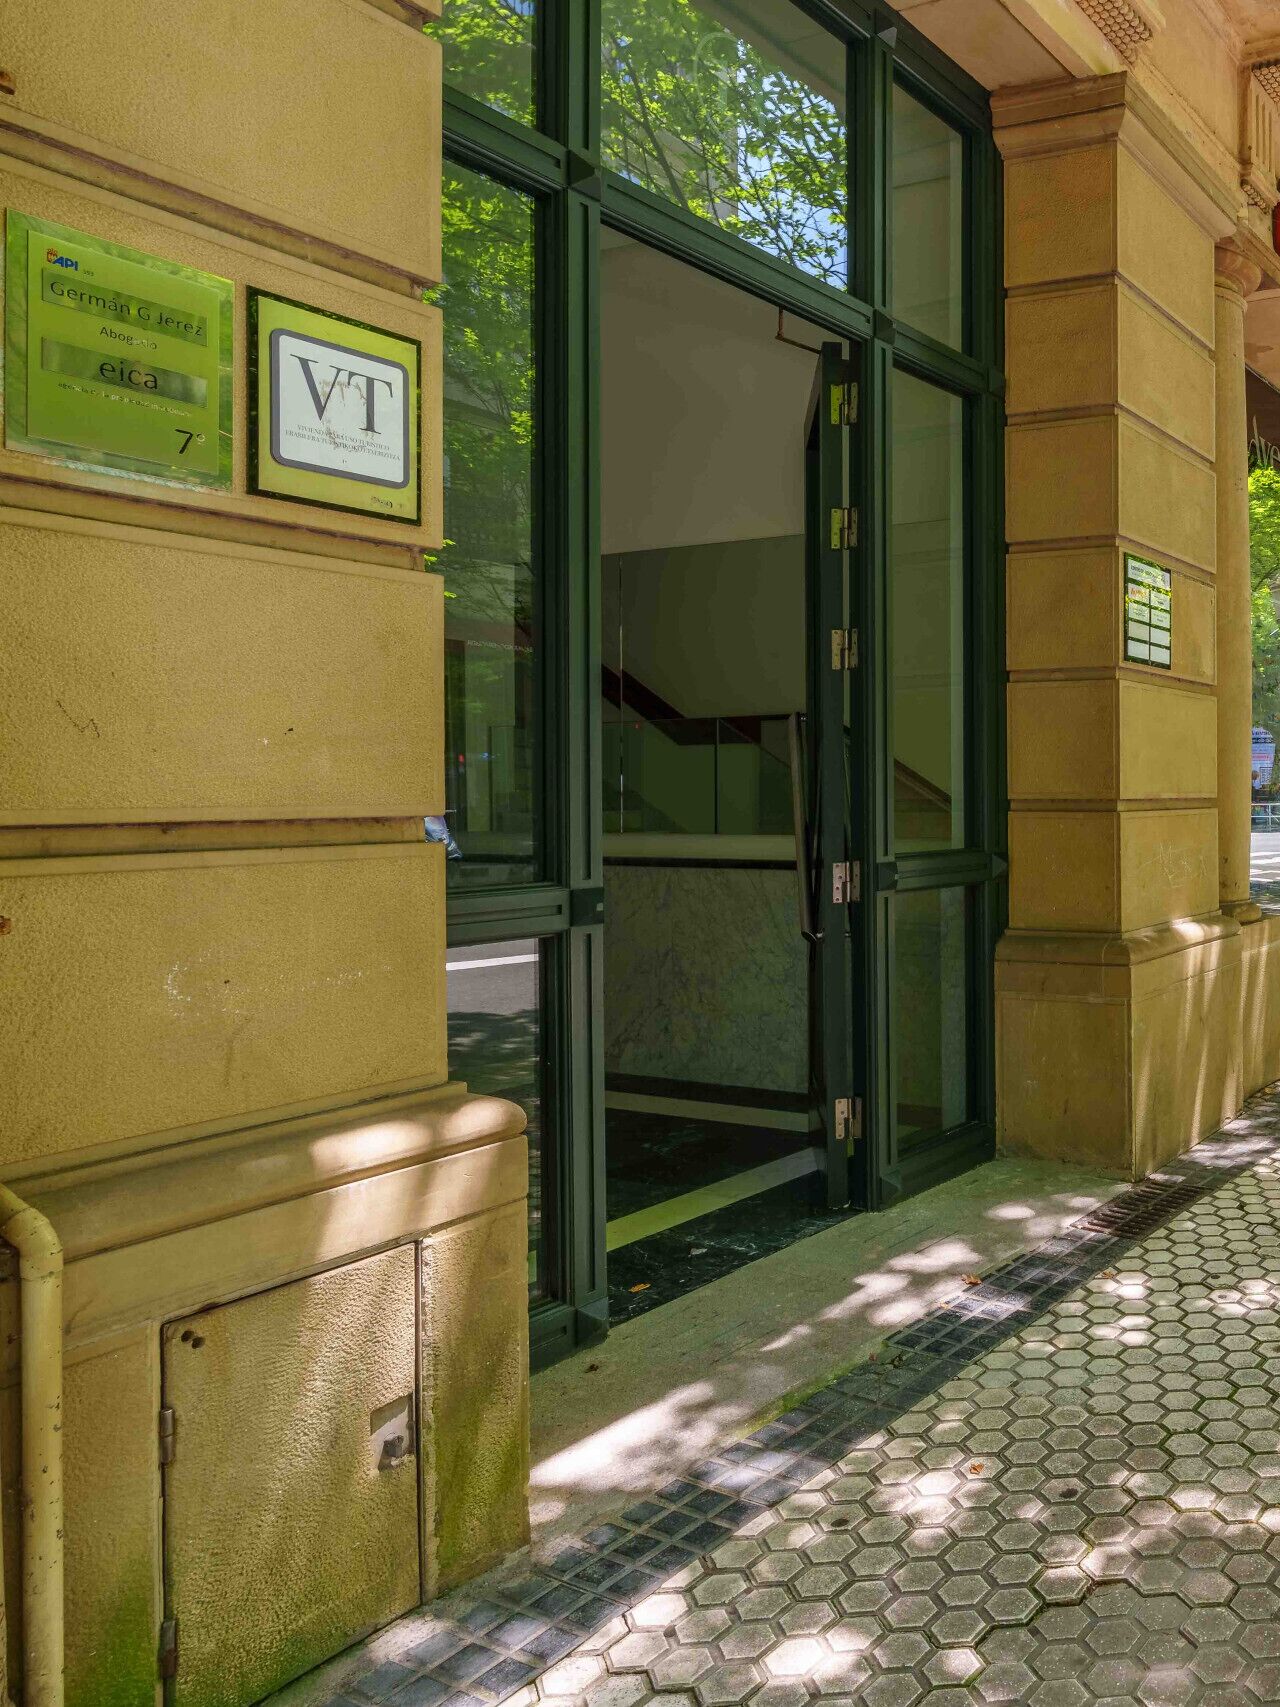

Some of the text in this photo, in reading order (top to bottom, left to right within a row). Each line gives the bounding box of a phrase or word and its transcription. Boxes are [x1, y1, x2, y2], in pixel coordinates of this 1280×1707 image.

[50, 281, 204, 337] Germán G Jerez
[99, 361, 159, 390] eica
[290, 353, 393, 435] VT
